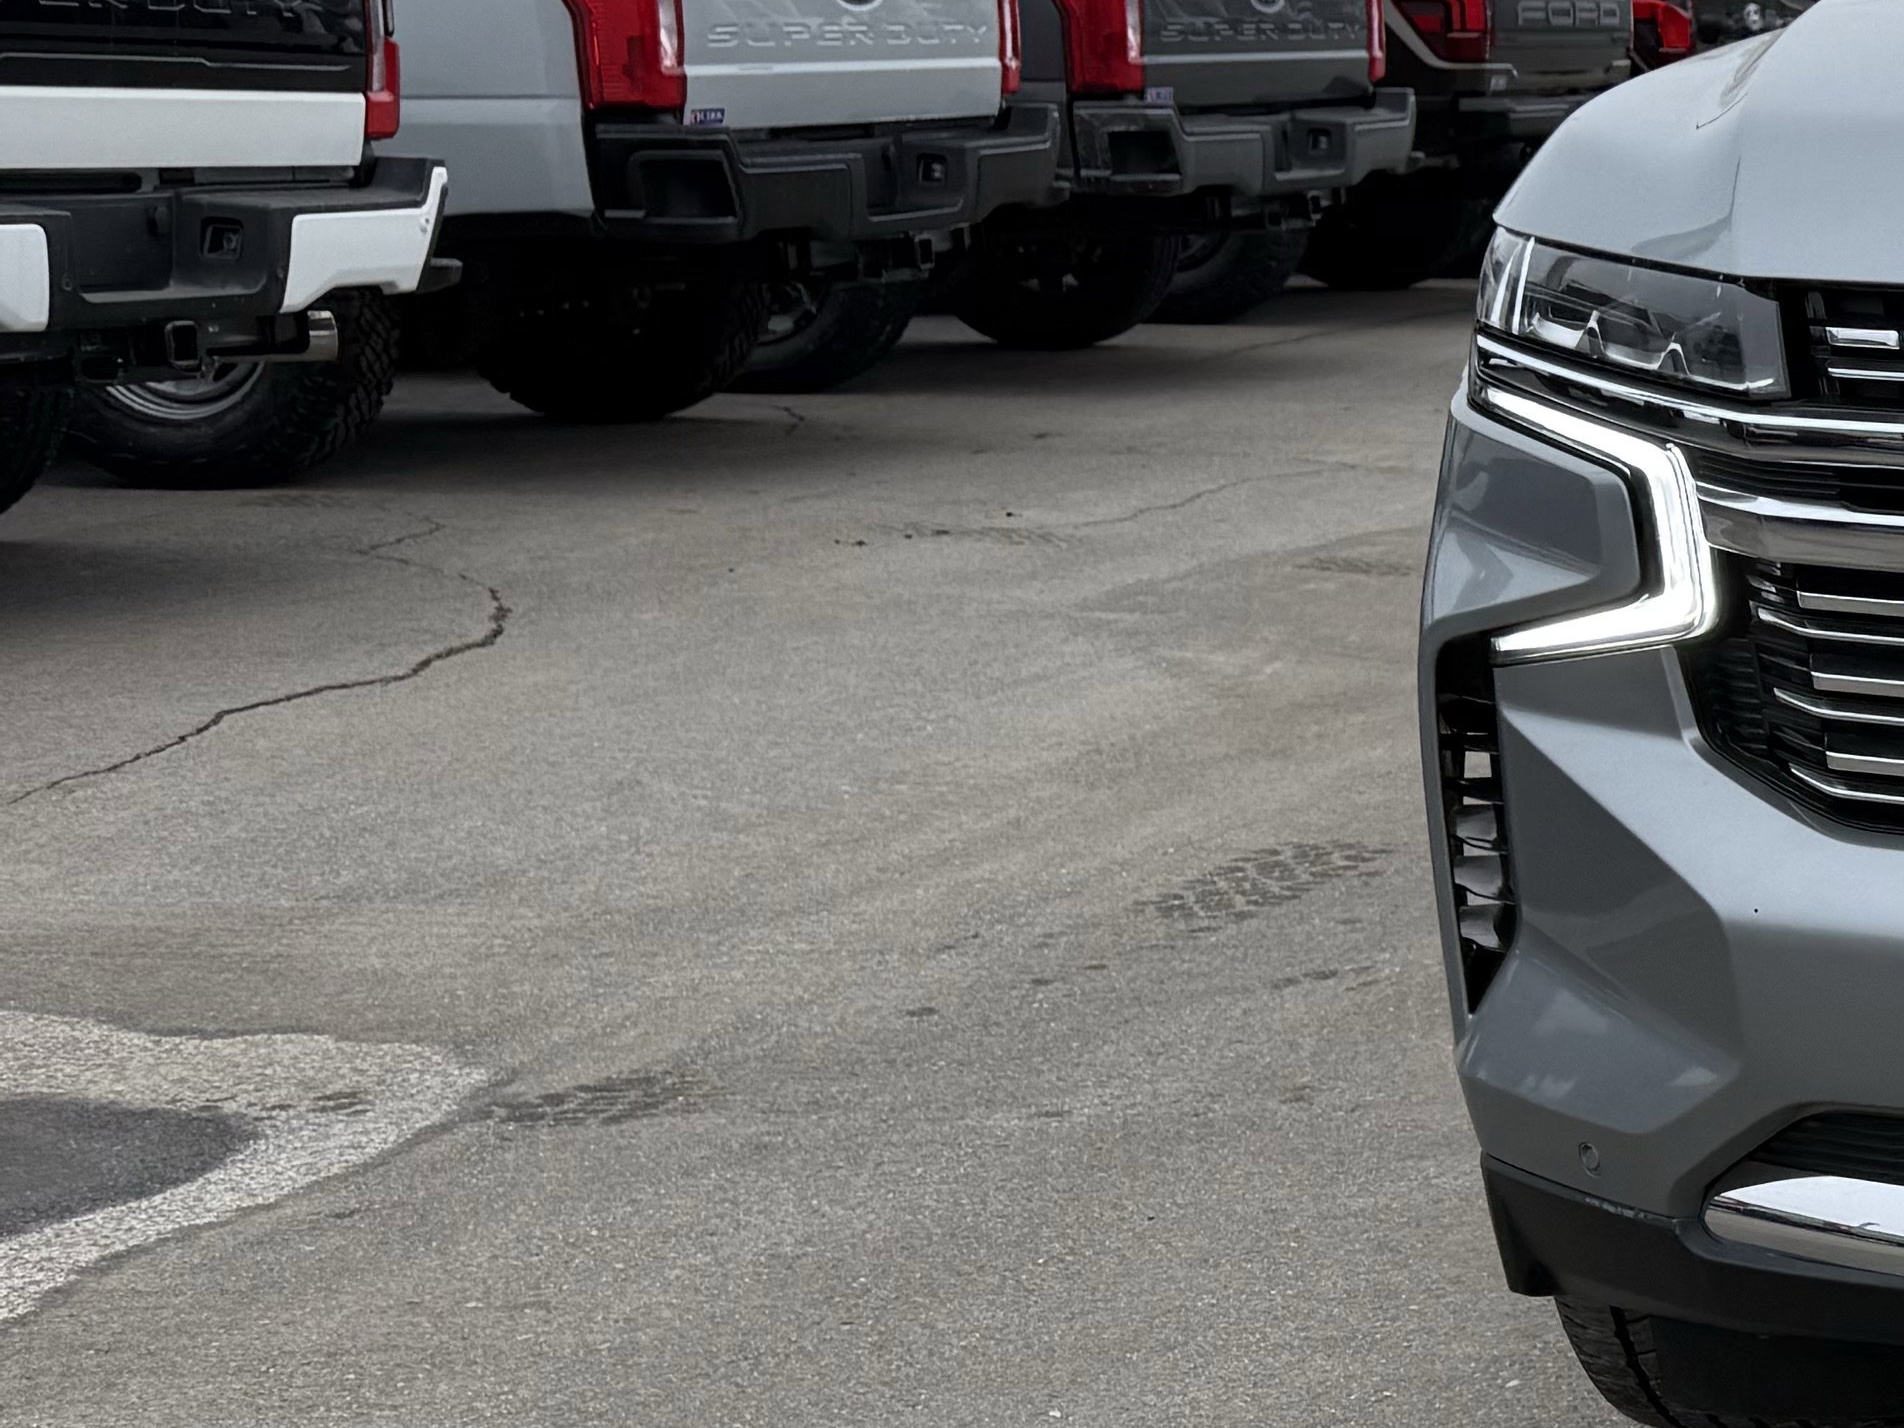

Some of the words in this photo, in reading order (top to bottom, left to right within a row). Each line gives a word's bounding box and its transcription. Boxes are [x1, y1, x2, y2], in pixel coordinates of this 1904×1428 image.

[1517, 0, 1620, 27] FORD
[707, 23, 874, 47] SUPER
[885, 23, 989, 45] DUTY
[1160, 23, 1280, 42] SUPER
